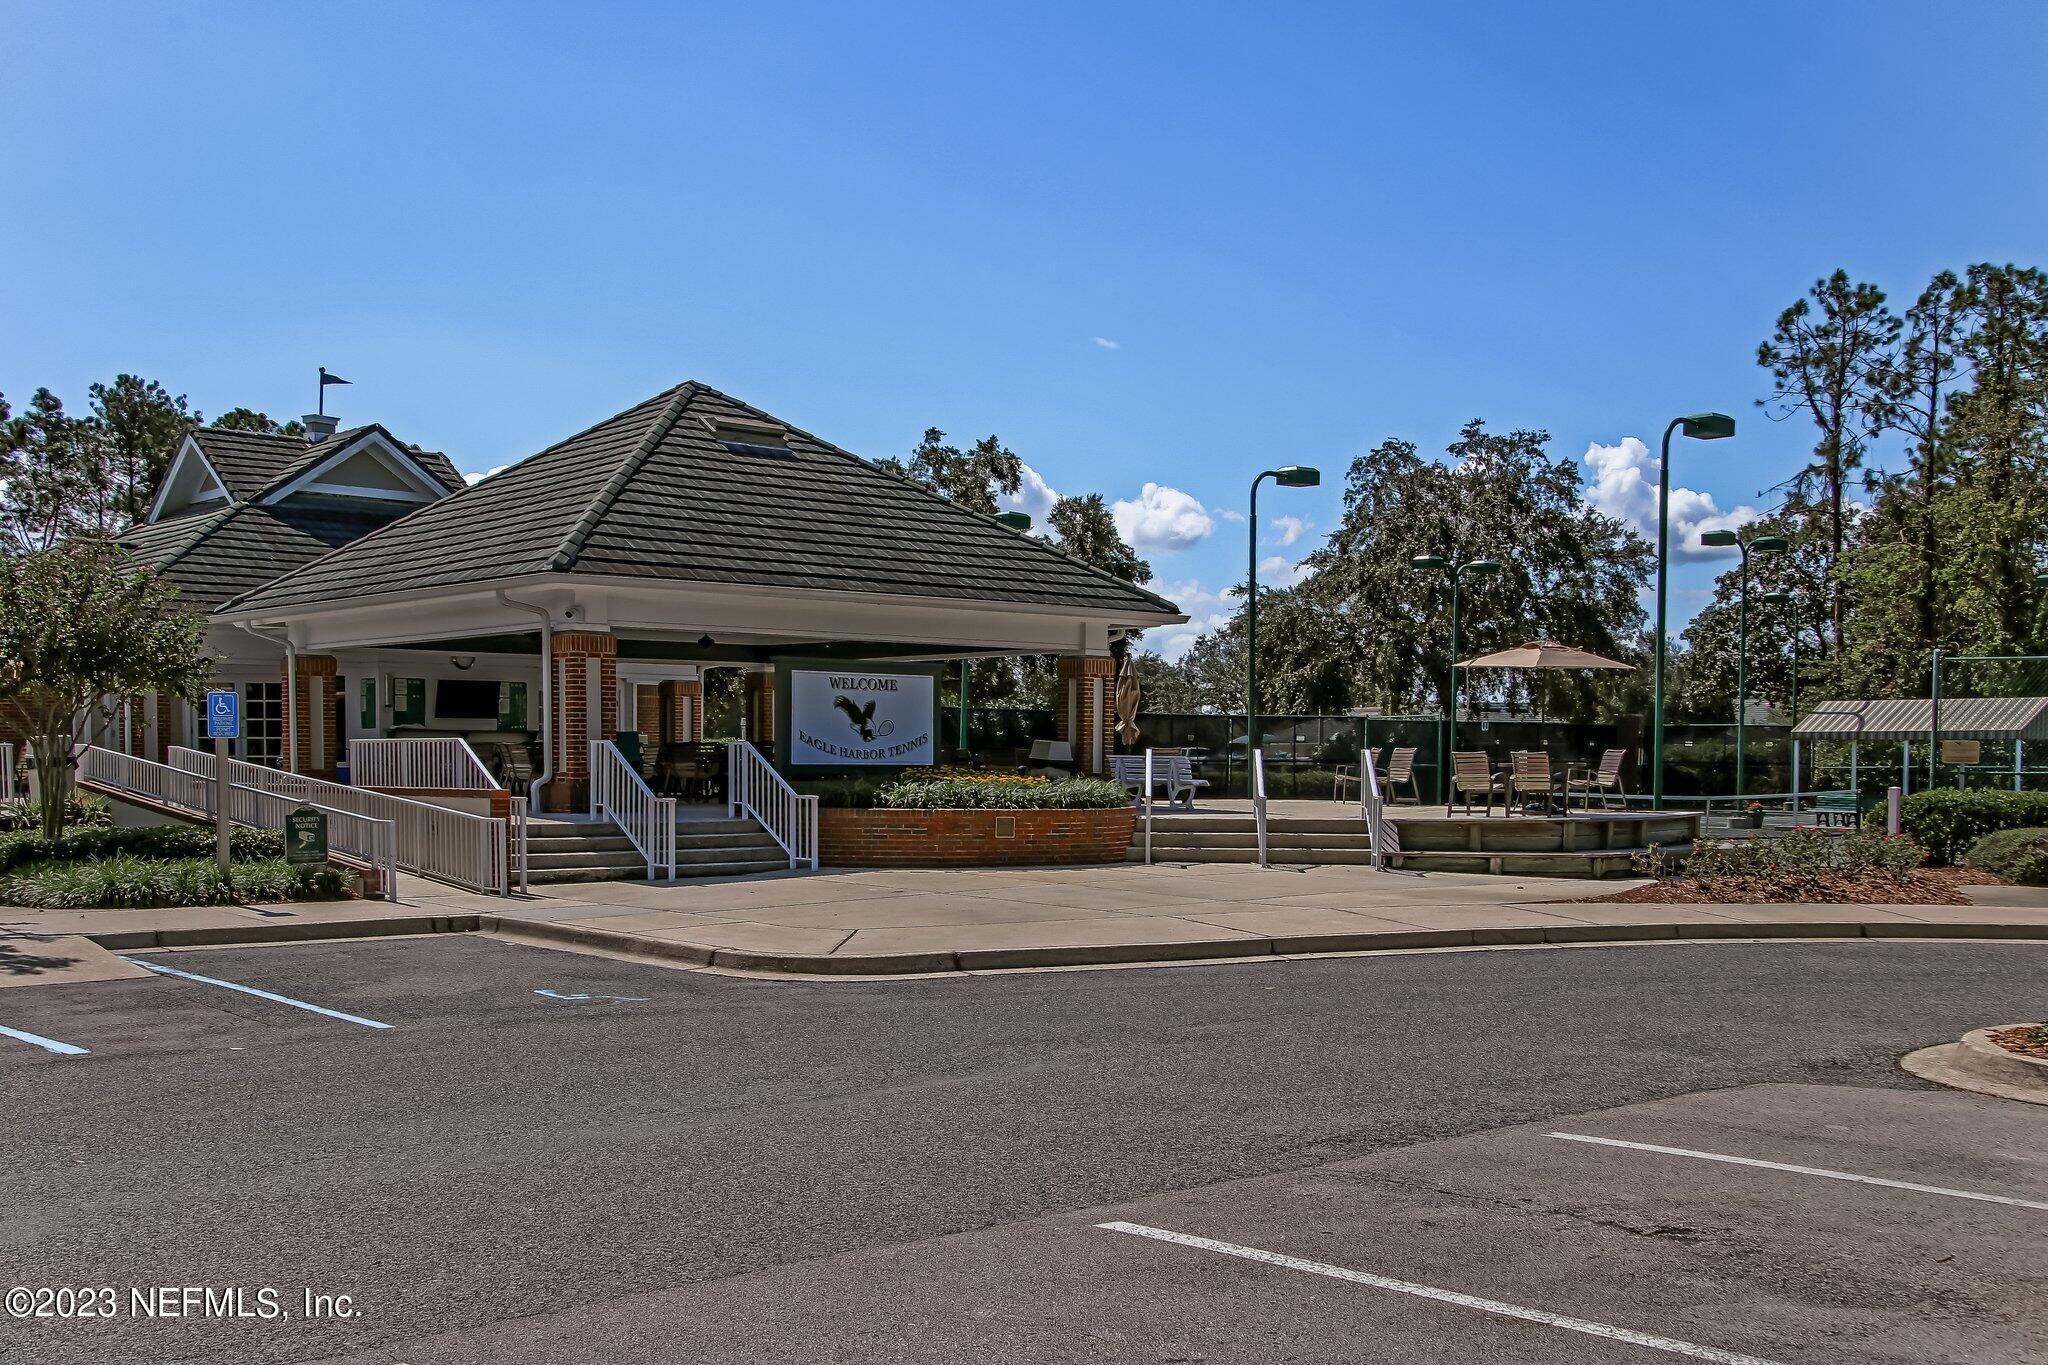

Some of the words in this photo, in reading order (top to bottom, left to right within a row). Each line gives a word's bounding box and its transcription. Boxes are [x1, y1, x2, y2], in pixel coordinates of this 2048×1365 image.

[829, 676, 898, 691] WELCOME
[799, 730, 836, 756] EAGLE
[839, 746, 887, 761] HARBOR
[888, 732, 928, 756] TENNIS
